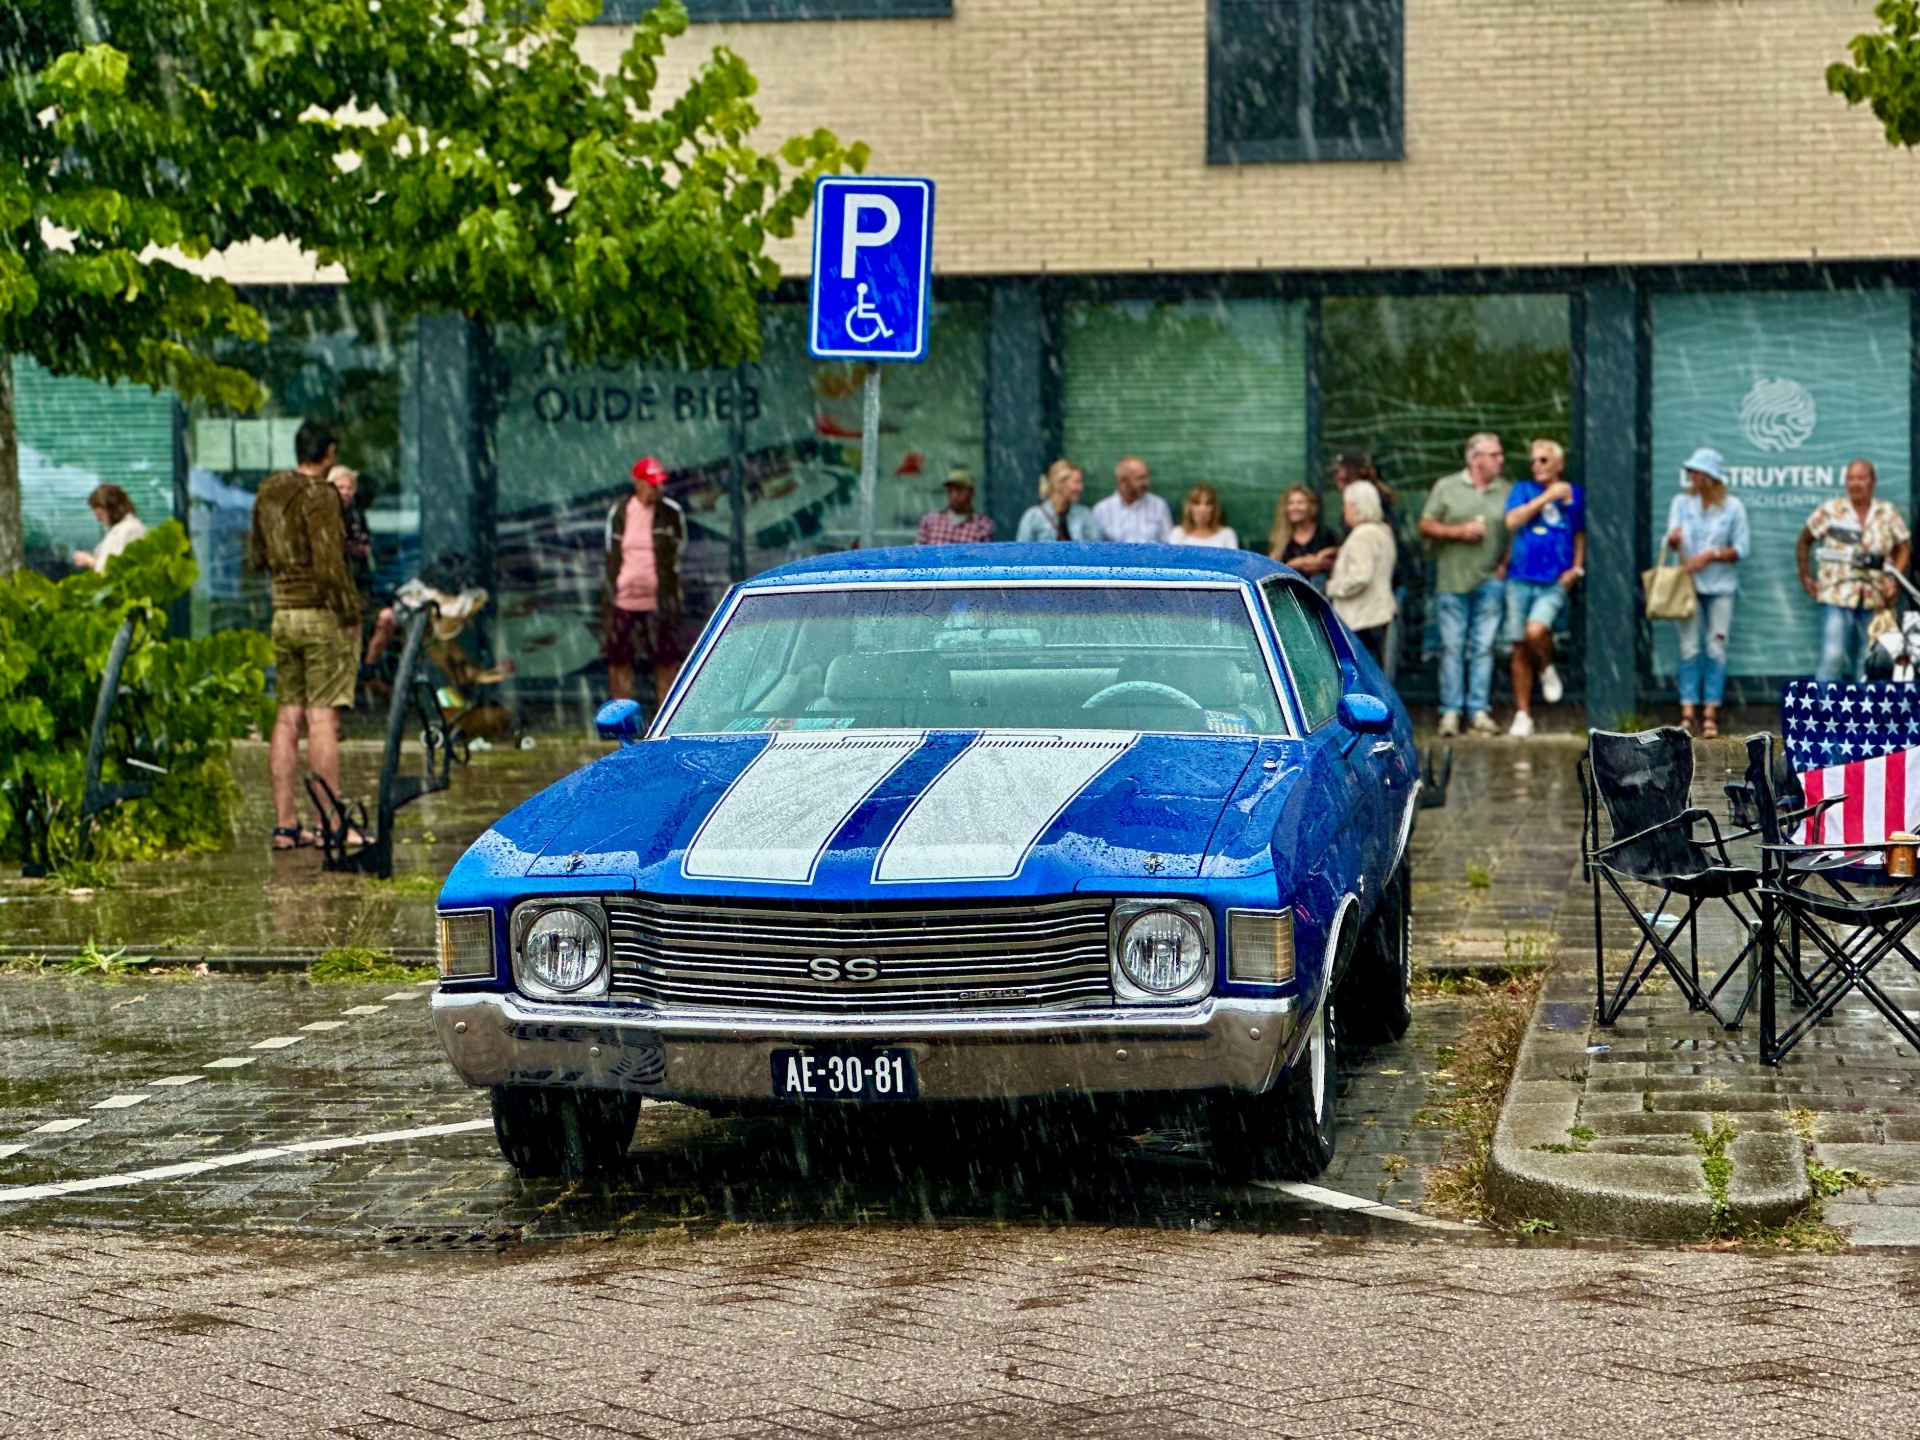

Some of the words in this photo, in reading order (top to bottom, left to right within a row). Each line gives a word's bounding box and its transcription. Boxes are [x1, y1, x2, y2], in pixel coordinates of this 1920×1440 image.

[841, 193, 901, 279] P
[533, 386, 657, 423] OUDE
[674, 386, 761, 422] BIEB
[1679, 466, 1833, 488] LSTRUYTEN
[809, 957, 879, 981] SS
[959, 990, 1026, 1000] CHEVELLE
[786, 1056, 904, 1093] AE-30-81
